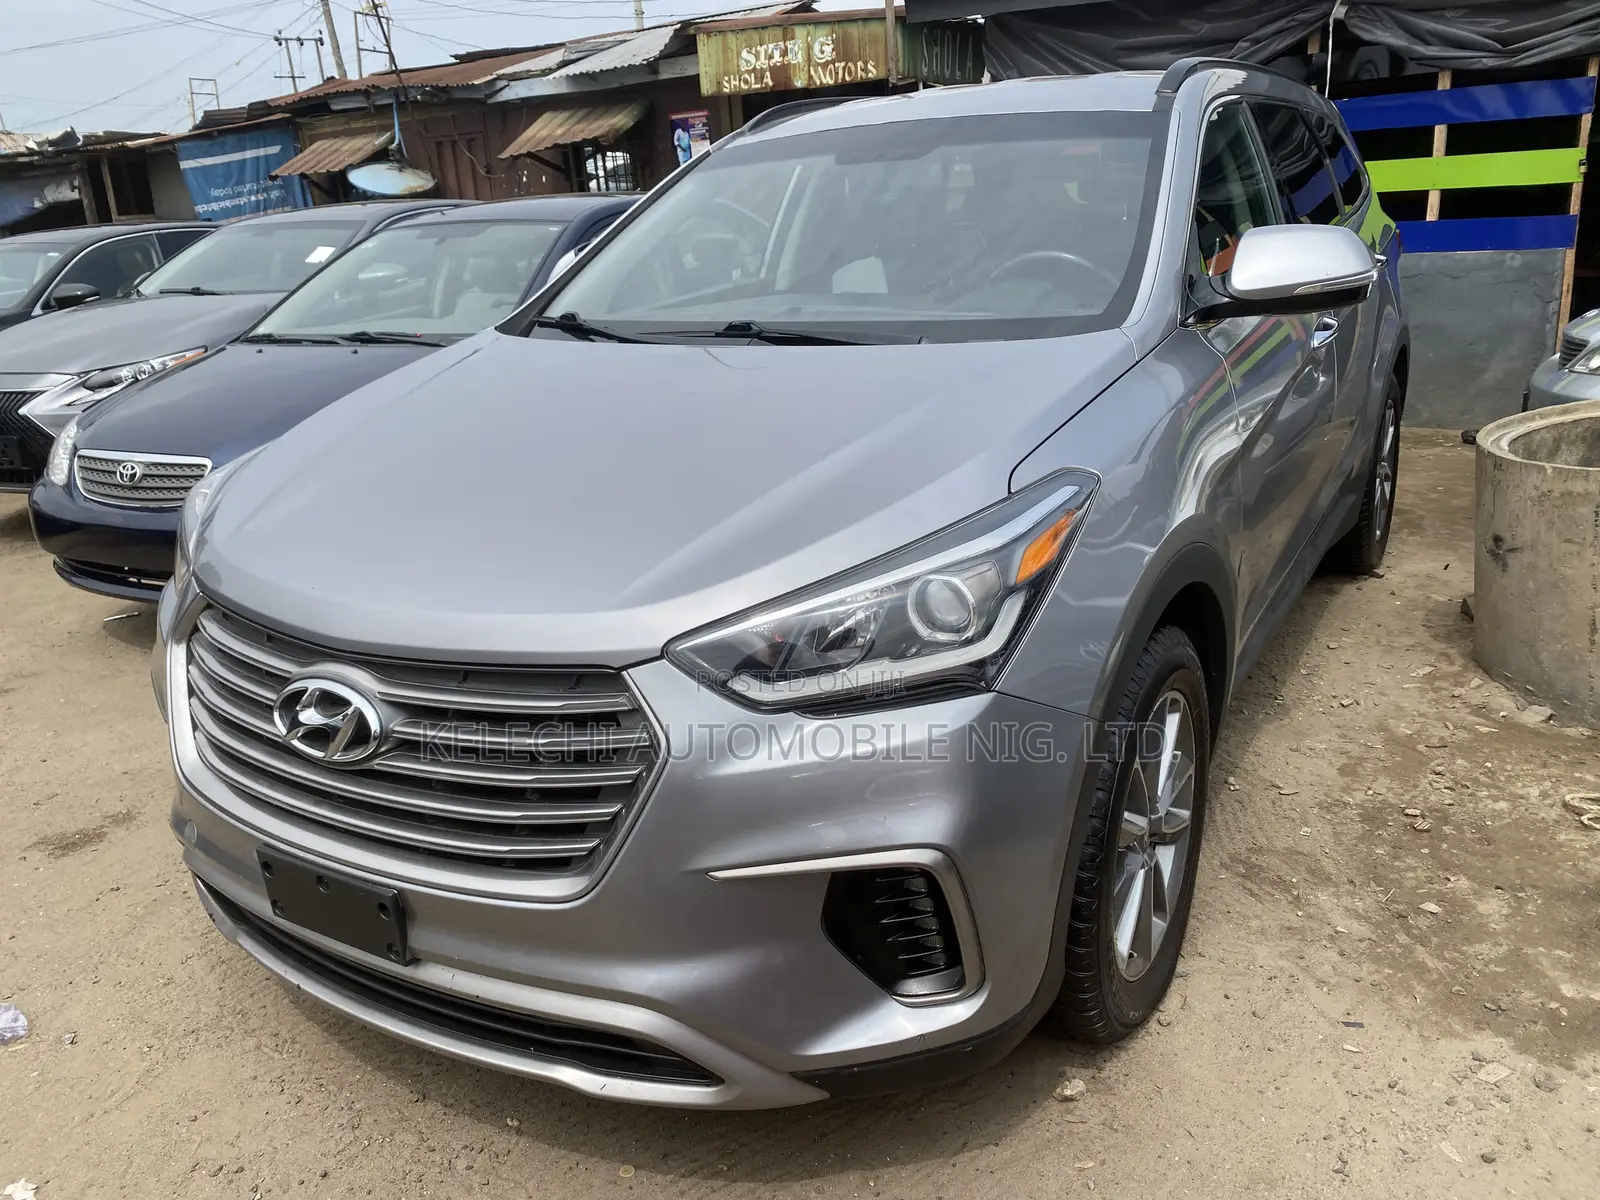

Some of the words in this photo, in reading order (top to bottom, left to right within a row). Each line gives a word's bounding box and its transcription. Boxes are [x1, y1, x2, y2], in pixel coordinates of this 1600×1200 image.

[921, 26, 973, 81] SHOLA
[723, 71, 774, 93] SHOLA
[810, 60, 878, 86] MOTORS
